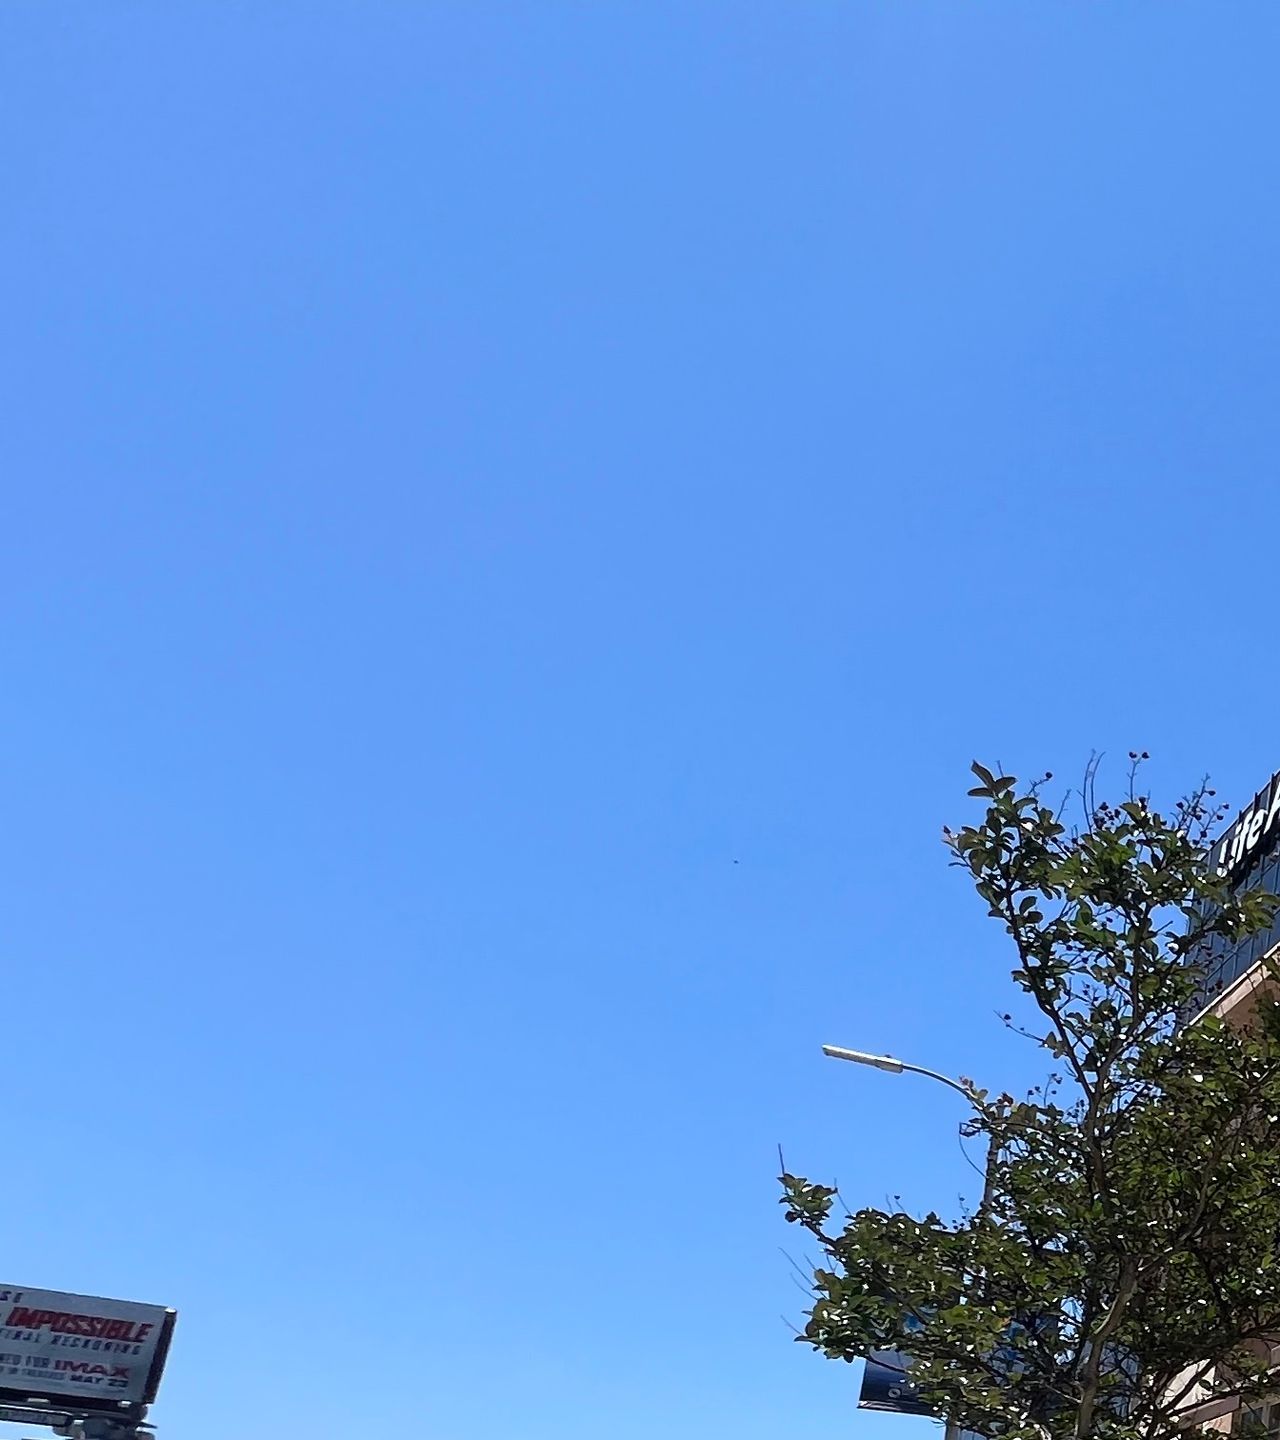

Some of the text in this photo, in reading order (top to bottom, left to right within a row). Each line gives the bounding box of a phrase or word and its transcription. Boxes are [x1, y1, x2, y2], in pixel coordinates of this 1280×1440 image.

[6, 1306, 154, 1342] IMPOSSIBLE
[54, 1359, 130, 1379] IMAX
[70, 1374, 104, 1385] MAY
